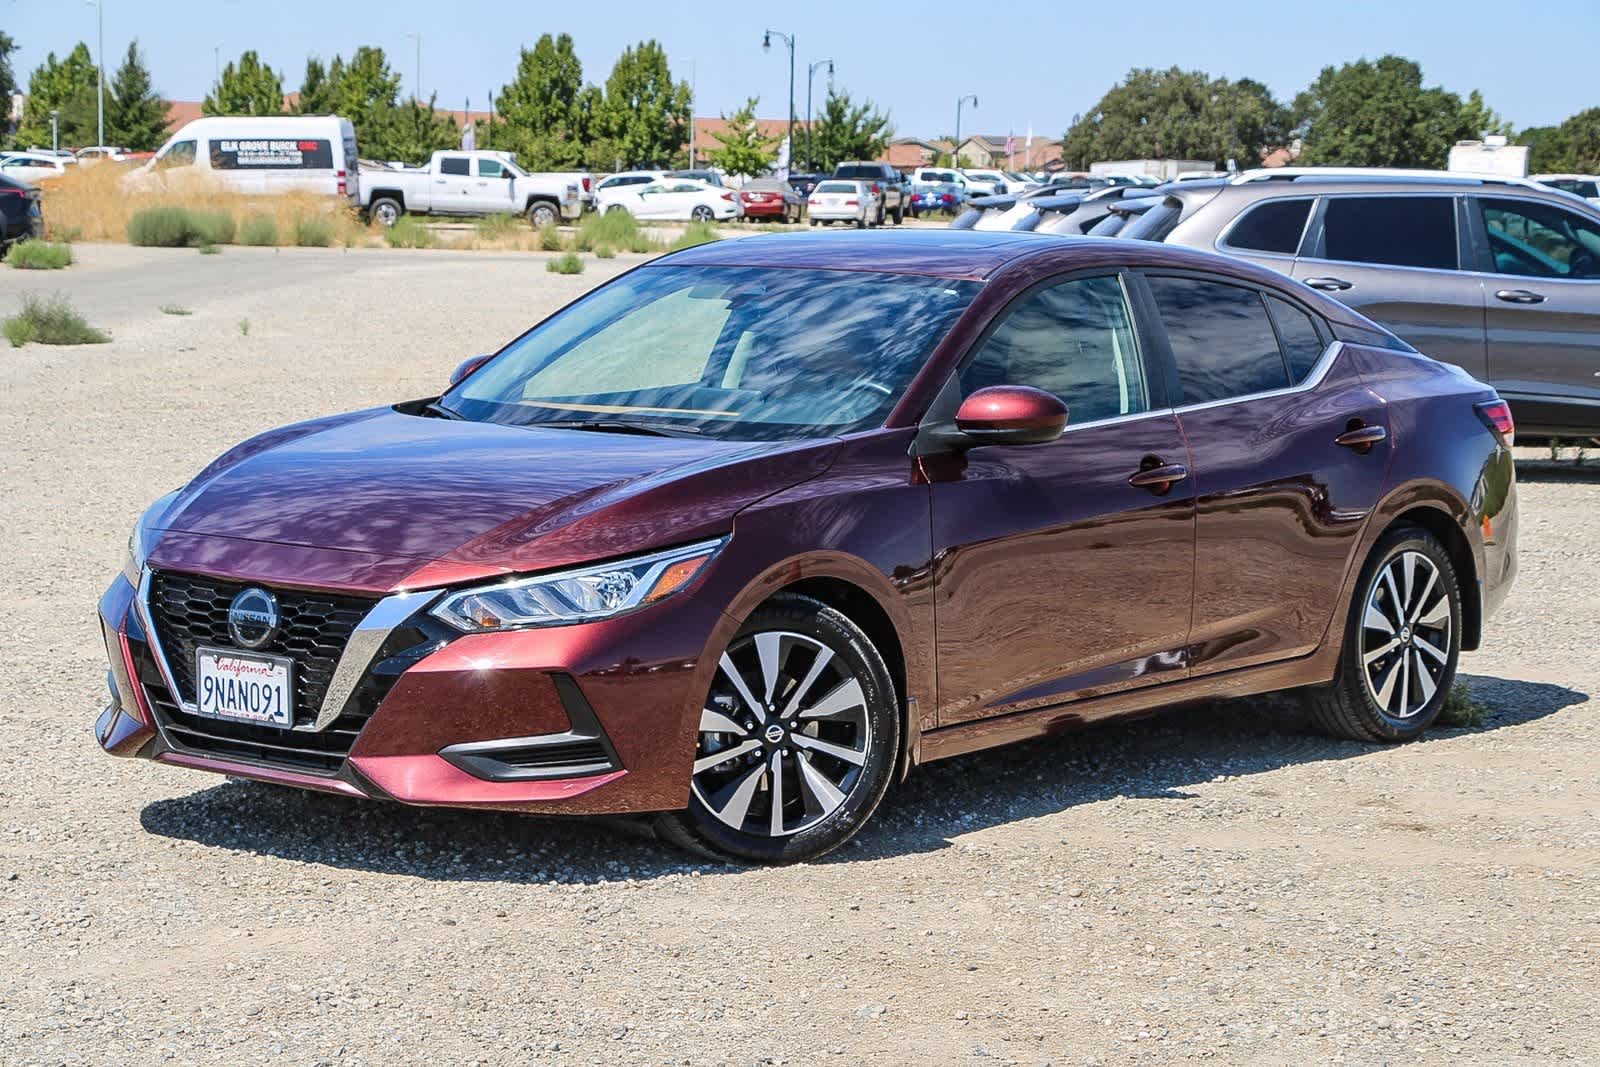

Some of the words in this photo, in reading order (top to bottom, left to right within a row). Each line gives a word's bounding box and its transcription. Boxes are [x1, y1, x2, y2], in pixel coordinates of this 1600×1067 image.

[220, 141, 239, 152] ELK
[239, 141, 269, 151] GROVE
[270, 141, 298, 151] BUICK
[232, 610, 272, 625] NISSAN
[215, 657, 273, 677] California
[203, 676, 284, 718] 9NAN091
